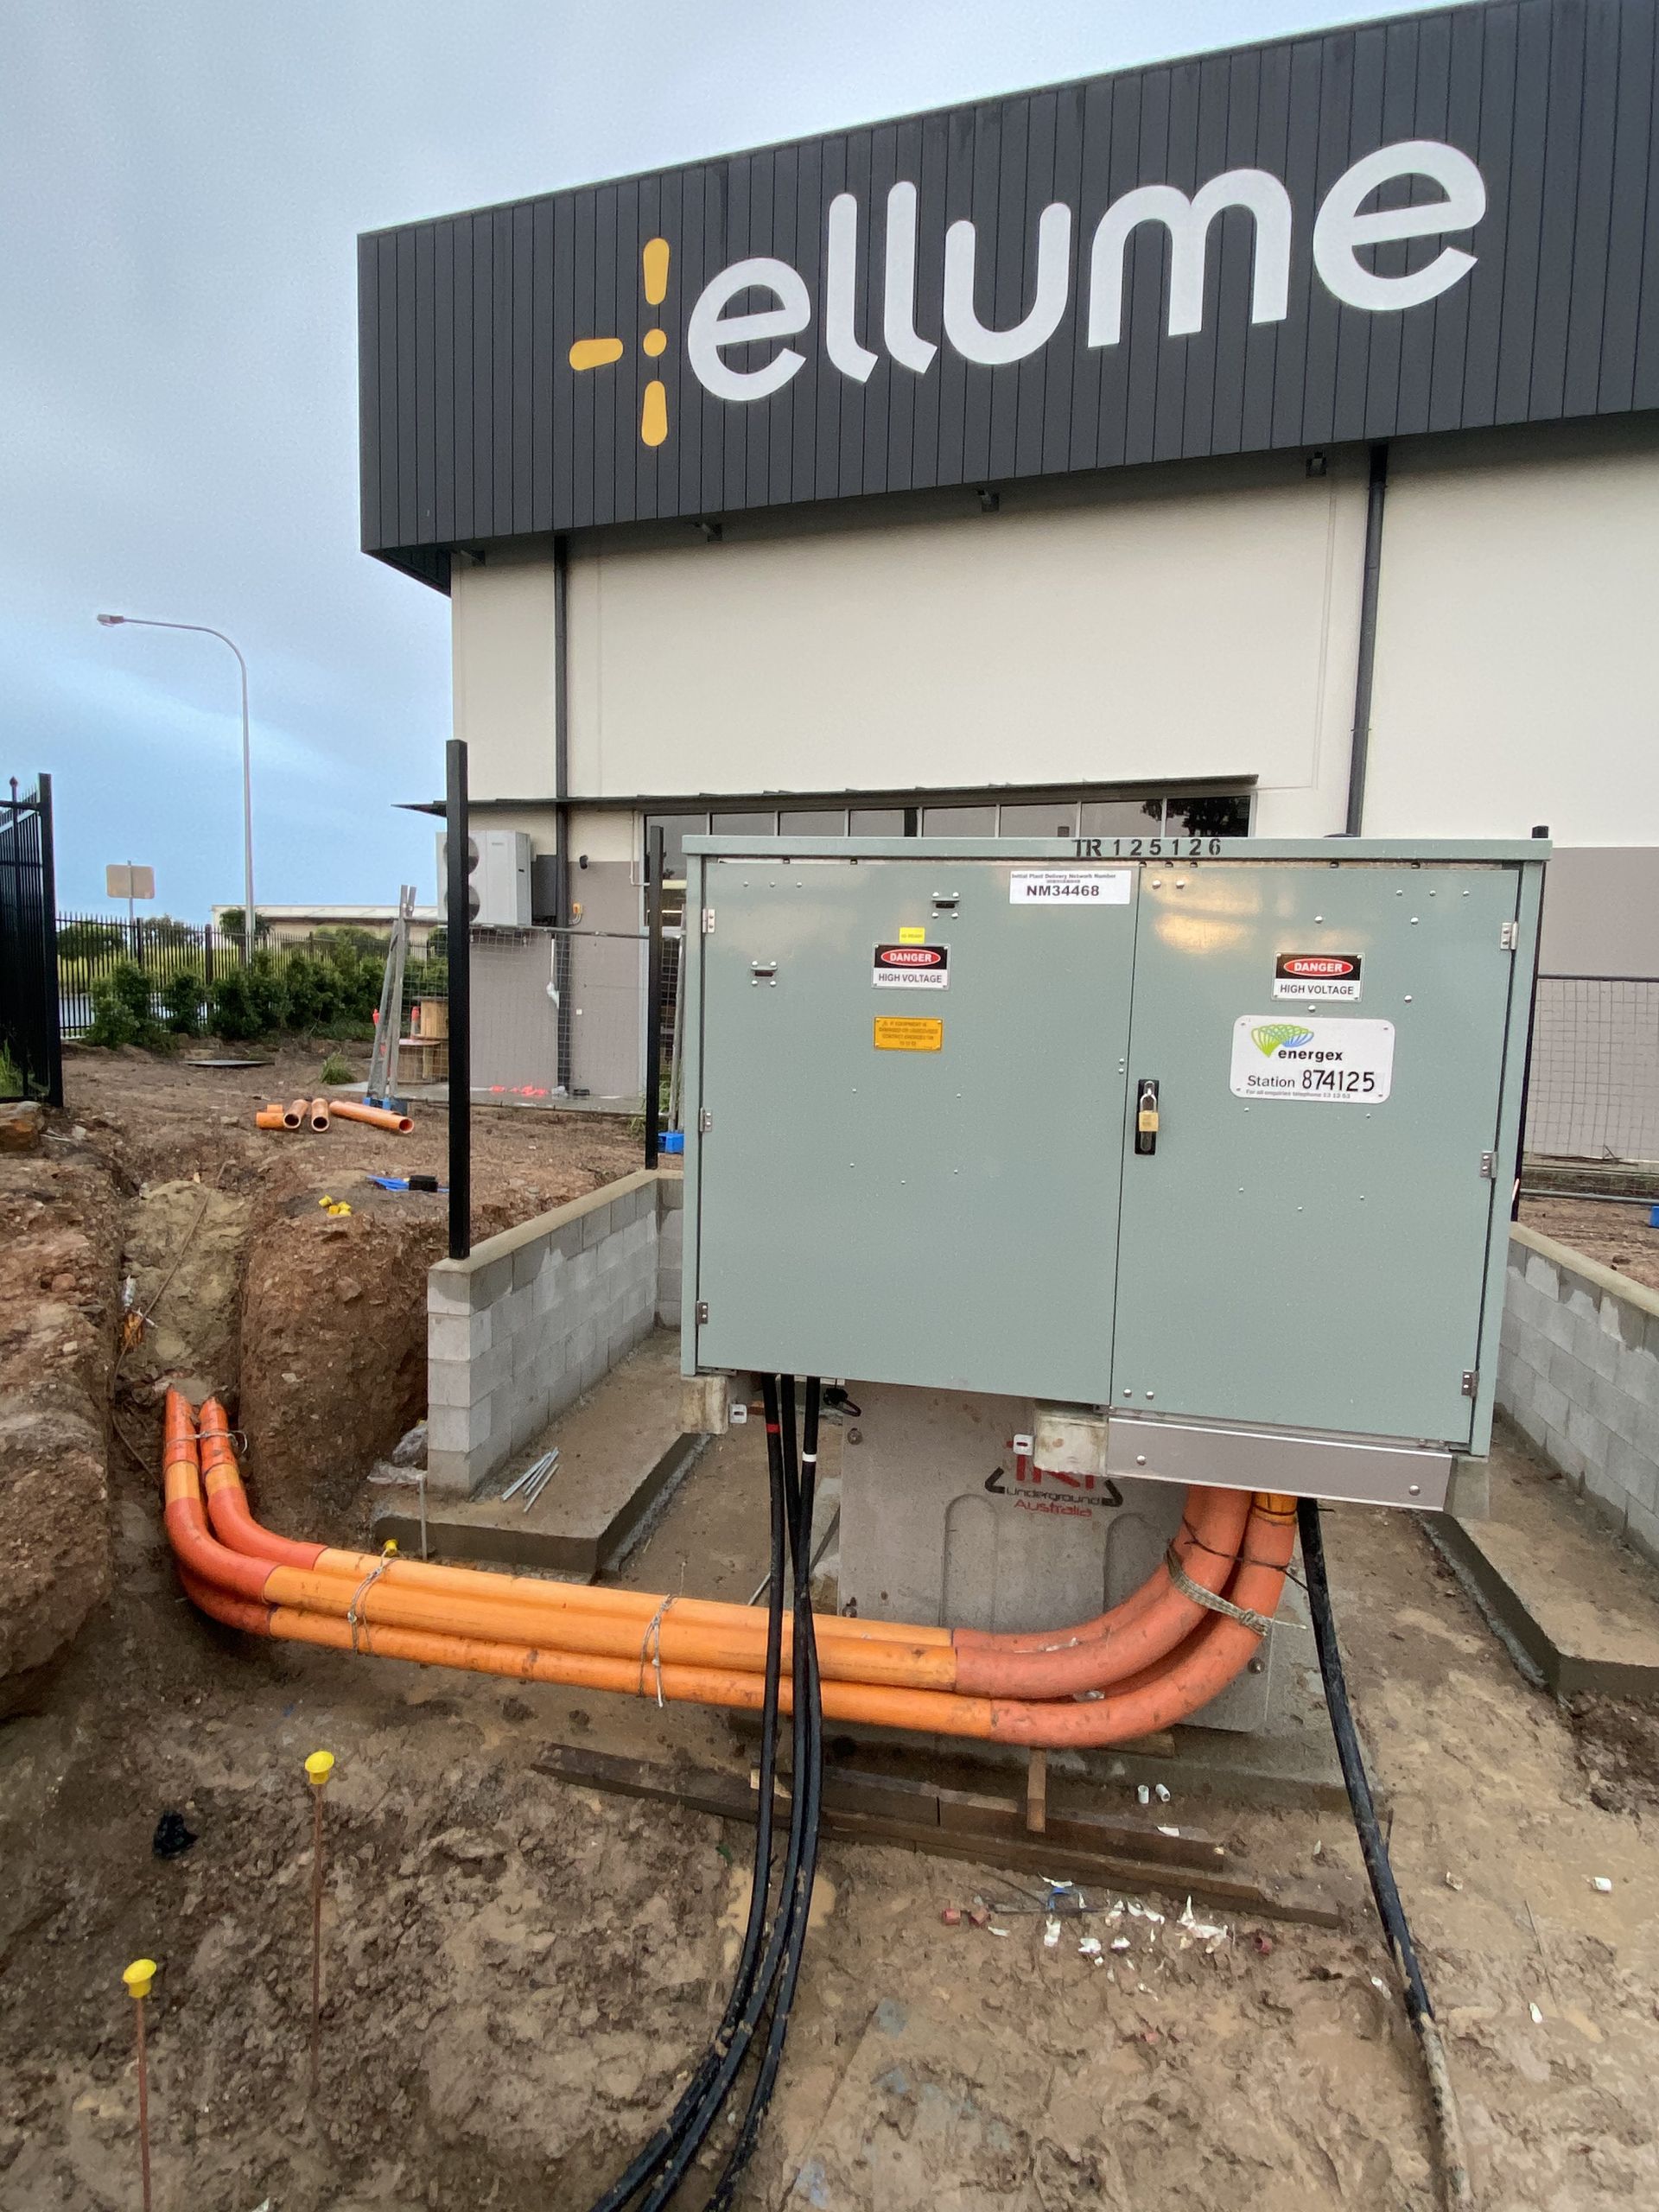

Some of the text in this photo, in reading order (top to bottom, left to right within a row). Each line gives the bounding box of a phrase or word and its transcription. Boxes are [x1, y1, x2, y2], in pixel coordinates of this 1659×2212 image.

[687, 140, 1487, 403] ellume
[1072, 839, 1102, 856] TR
[1027, 885, 1099, 896] NM34468
[890, 952, 932, 962] DANGER
[1294, 962, 1343, 973] DANGER
[879, 973, 942, 983] HIGH VOLTAGE
[1280, 984, 1354, 995] HIGH VOLTAGE
[1278, 1049, 1343, 1063] energex
[1247, 1069, 1375, 1092] Station 874125
[1006, 1486, 1100, 1505] Underground
[1014, 1498, 1093, 1517] Australia
